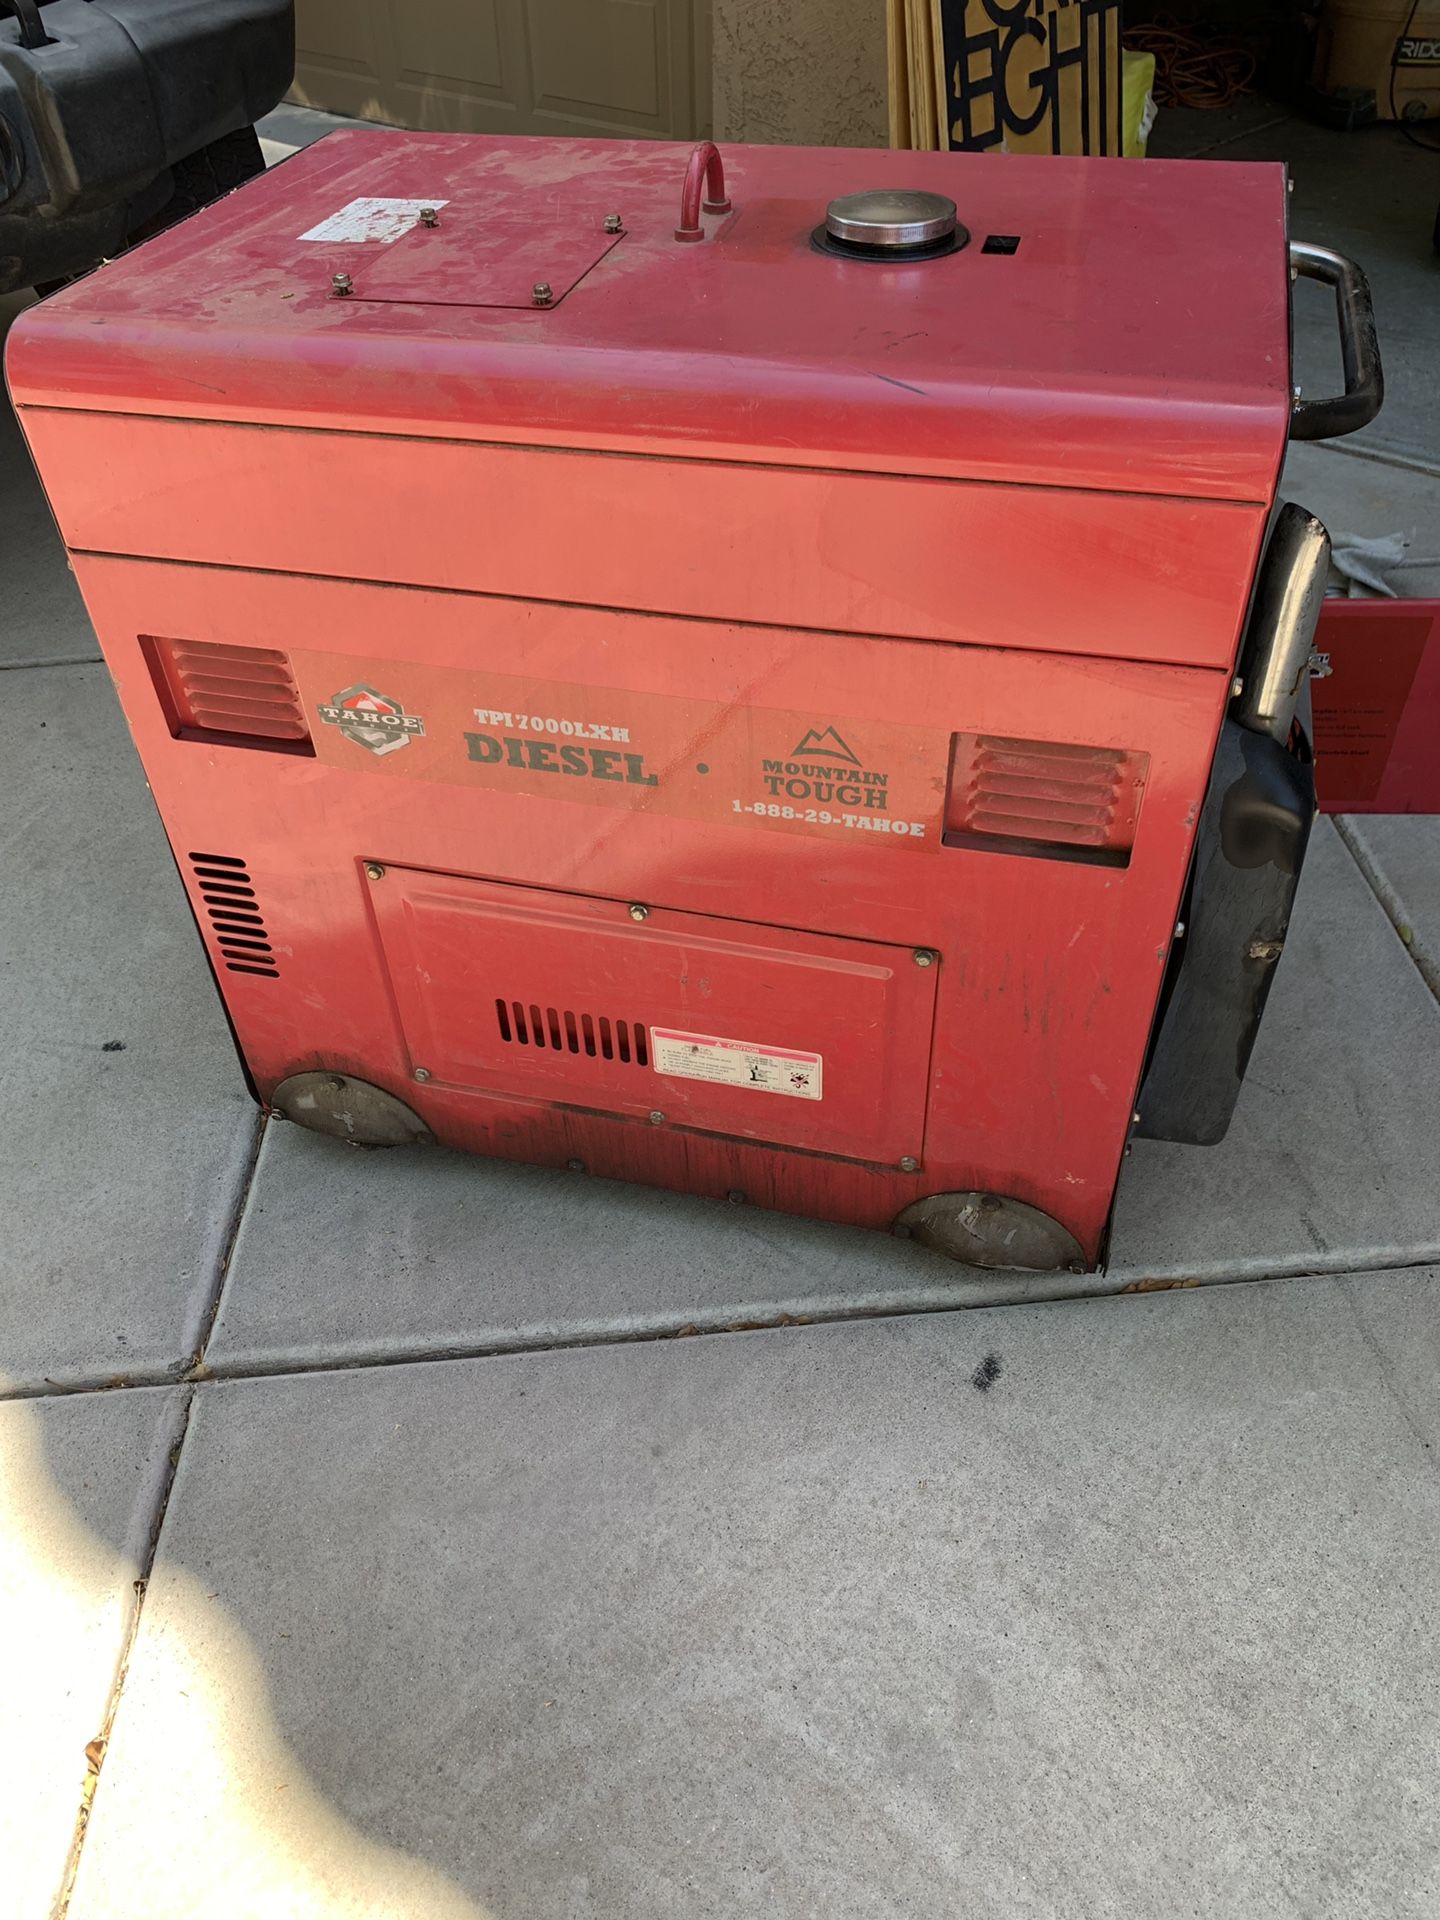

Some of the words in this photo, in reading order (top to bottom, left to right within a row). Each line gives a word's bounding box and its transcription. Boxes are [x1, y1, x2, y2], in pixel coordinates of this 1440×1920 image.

[322, 707, 419, 728] TAHOE
[473, 708, 630, 743] TPI7000LXH
[463, 732, 659, 786] DIESEL
[762, 759, 888, 786] MOUNTAIN
[763, 775, 888, 810] TOUGH
[732, 799, 925, 837] 1-888-29-TAHOE
[727, 1042, 760, 1053] CAUTION
